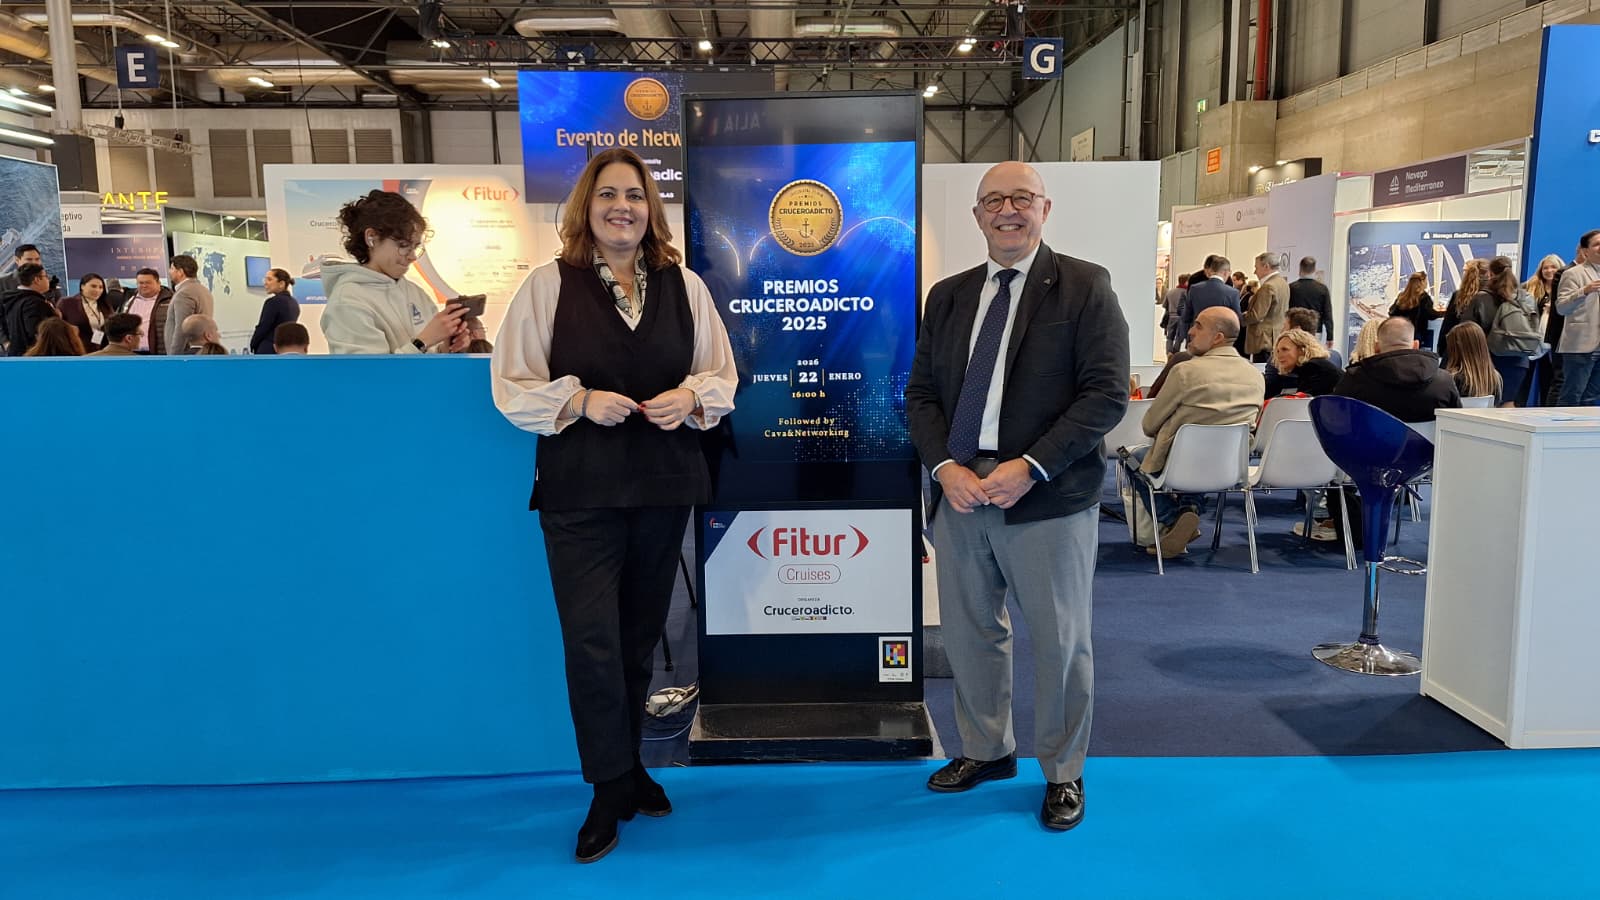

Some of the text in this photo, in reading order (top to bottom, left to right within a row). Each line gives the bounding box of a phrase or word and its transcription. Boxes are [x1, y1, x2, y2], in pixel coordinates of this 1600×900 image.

[1030, 43, 1055, 74] G
[127, 52, 147, 83] E
[556, 129, 615, 147] Evento
[618, 129, 639, 147] de
[474, 186, 509, 201] Fitur
[779, 207, 834, 215] CRUCEROADICTO
[763, 279, 839, 295] PREMIOS
[728, 297, 875, 313] CRUCEROADICTO
[781, 316, 827, 331] 2025
[796, 358, 820, 367] 2026
[752, 371, 862, 384] JUEVES 22 ENERO
[791, 389, 826, 399] 16:00 h
[778, 416, 836, 427] Followed by
[763, 429, 850, 439] Cava&Networking
[772, 527, 847, 557] Fitur
[786, 567, 831, 581] Cruises
[764, 604, 855, 616] Cruceroadicto.
